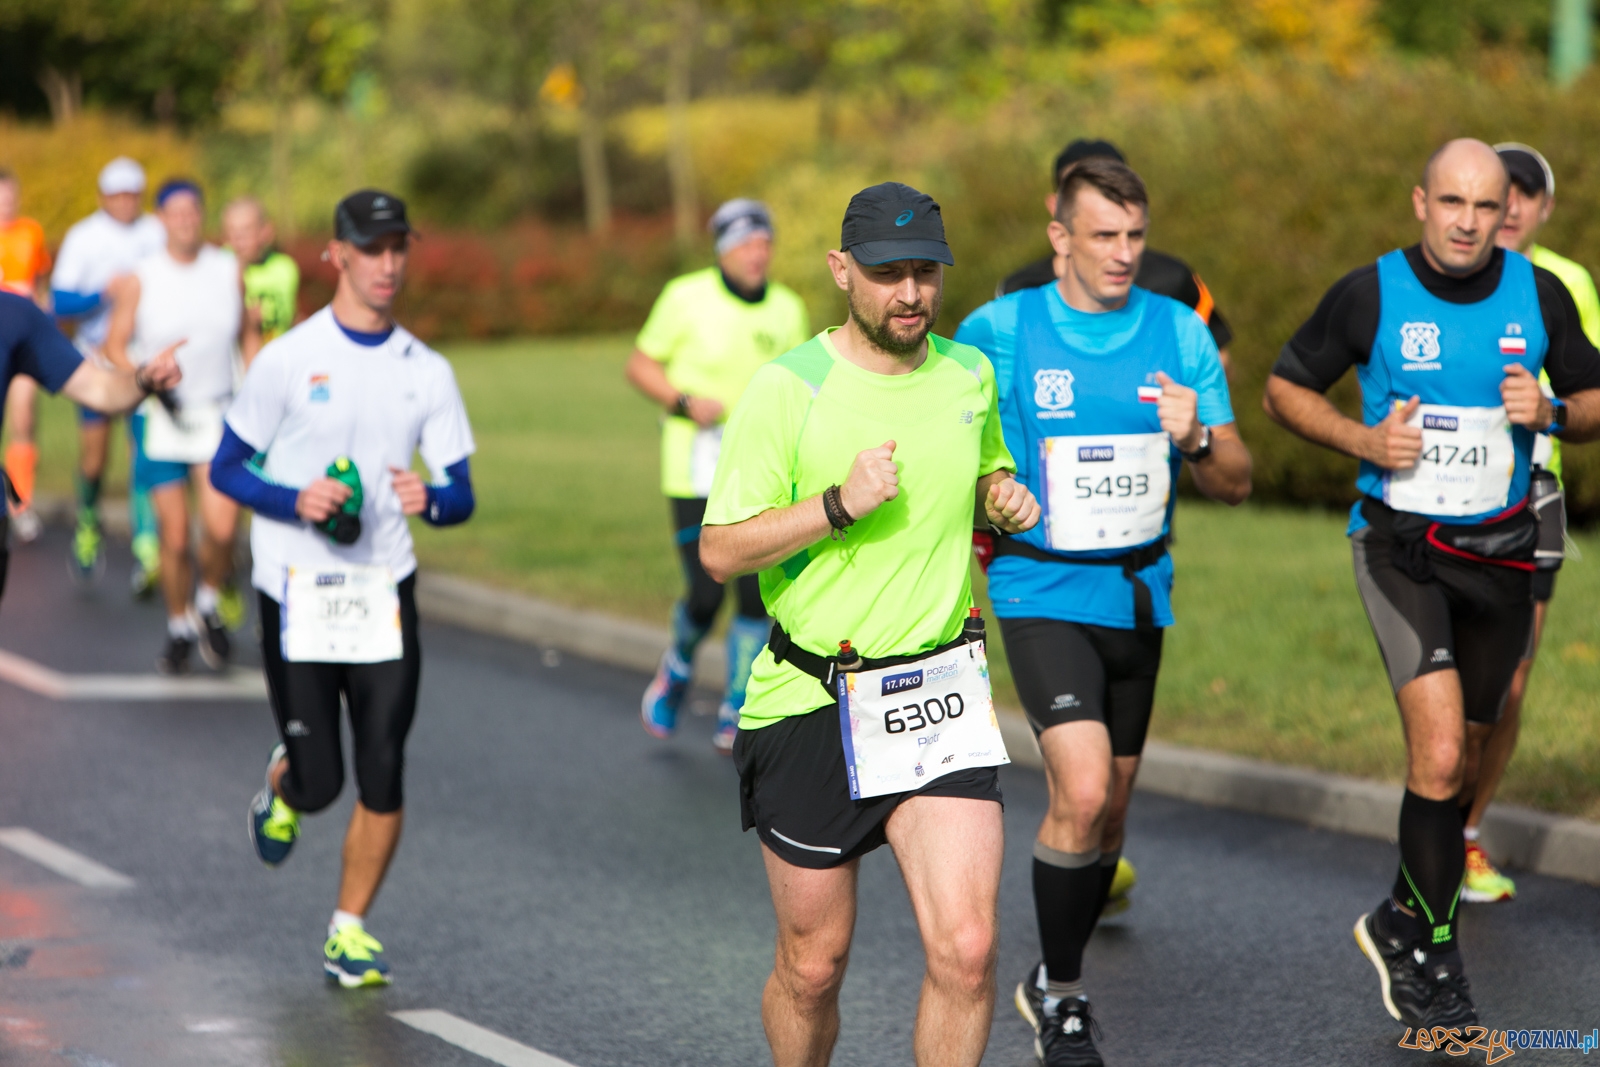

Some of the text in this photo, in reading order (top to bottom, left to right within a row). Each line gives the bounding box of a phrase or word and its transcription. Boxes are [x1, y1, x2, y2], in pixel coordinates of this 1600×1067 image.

[1422, 445, 1488, 467] 4741
[1075, 474, 1149, 499] 5493
[318, 596, 370, 620] 3175
[926, 669, 959, 683] maraton
[884, 692, 964, 734] 6300
[917, 733, 940, 748] Piotr
